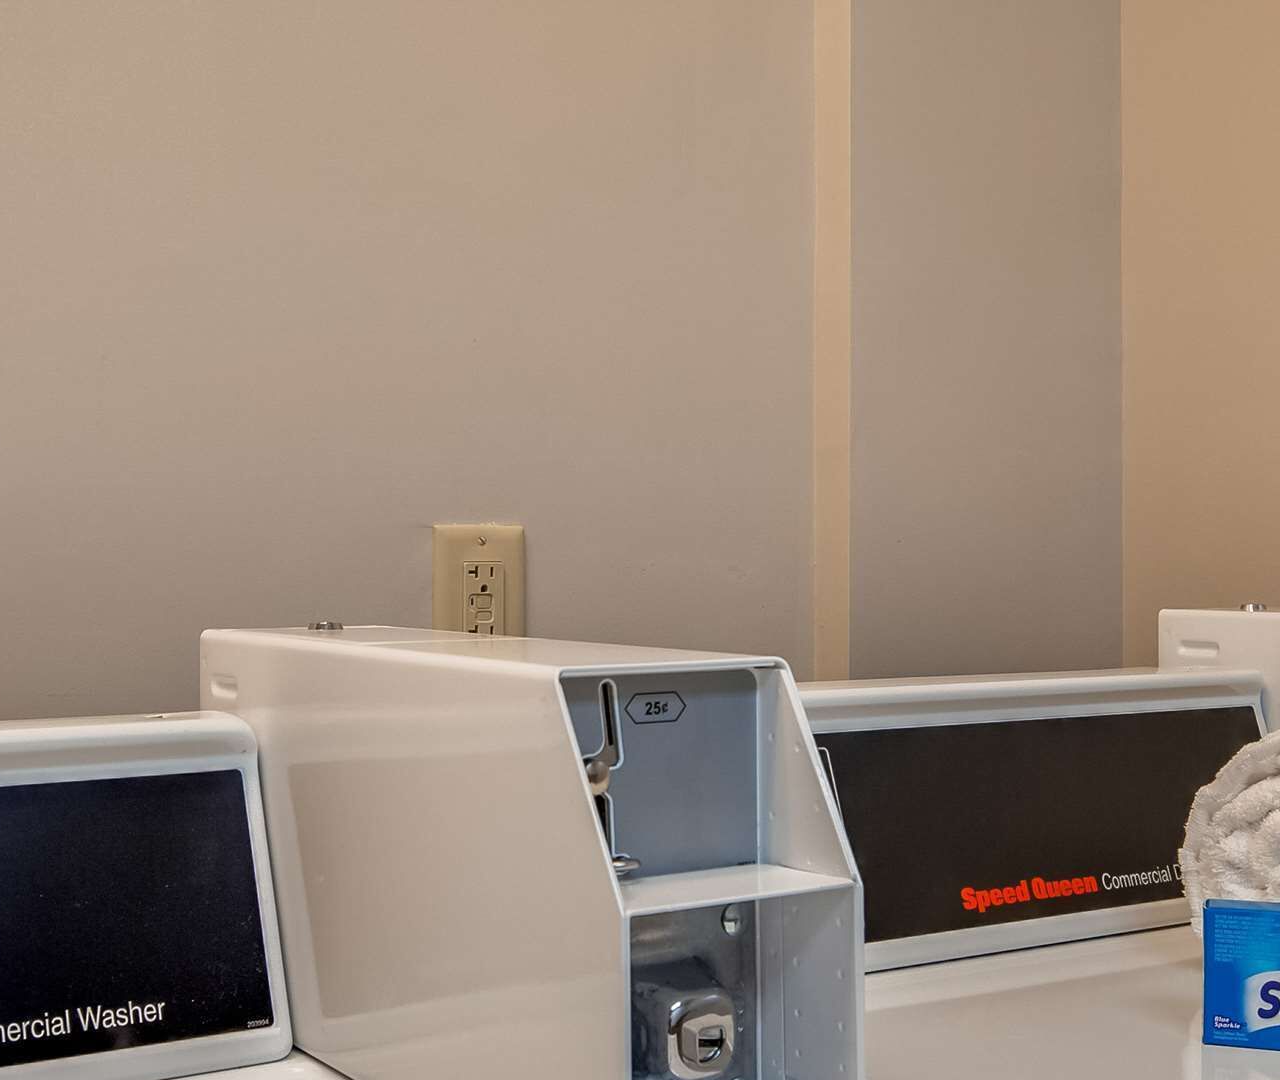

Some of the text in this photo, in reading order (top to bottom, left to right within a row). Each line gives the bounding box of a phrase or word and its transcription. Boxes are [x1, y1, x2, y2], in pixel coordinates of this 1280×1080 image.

[645, 701, 669, 716] 25¢
[961, 880, 1030, 912] Speed
[1031, 875, 1099, 899] Queen
[1101, 864, 1172, 891] Commercial
[76, 1000, 166, 1032] Washer
